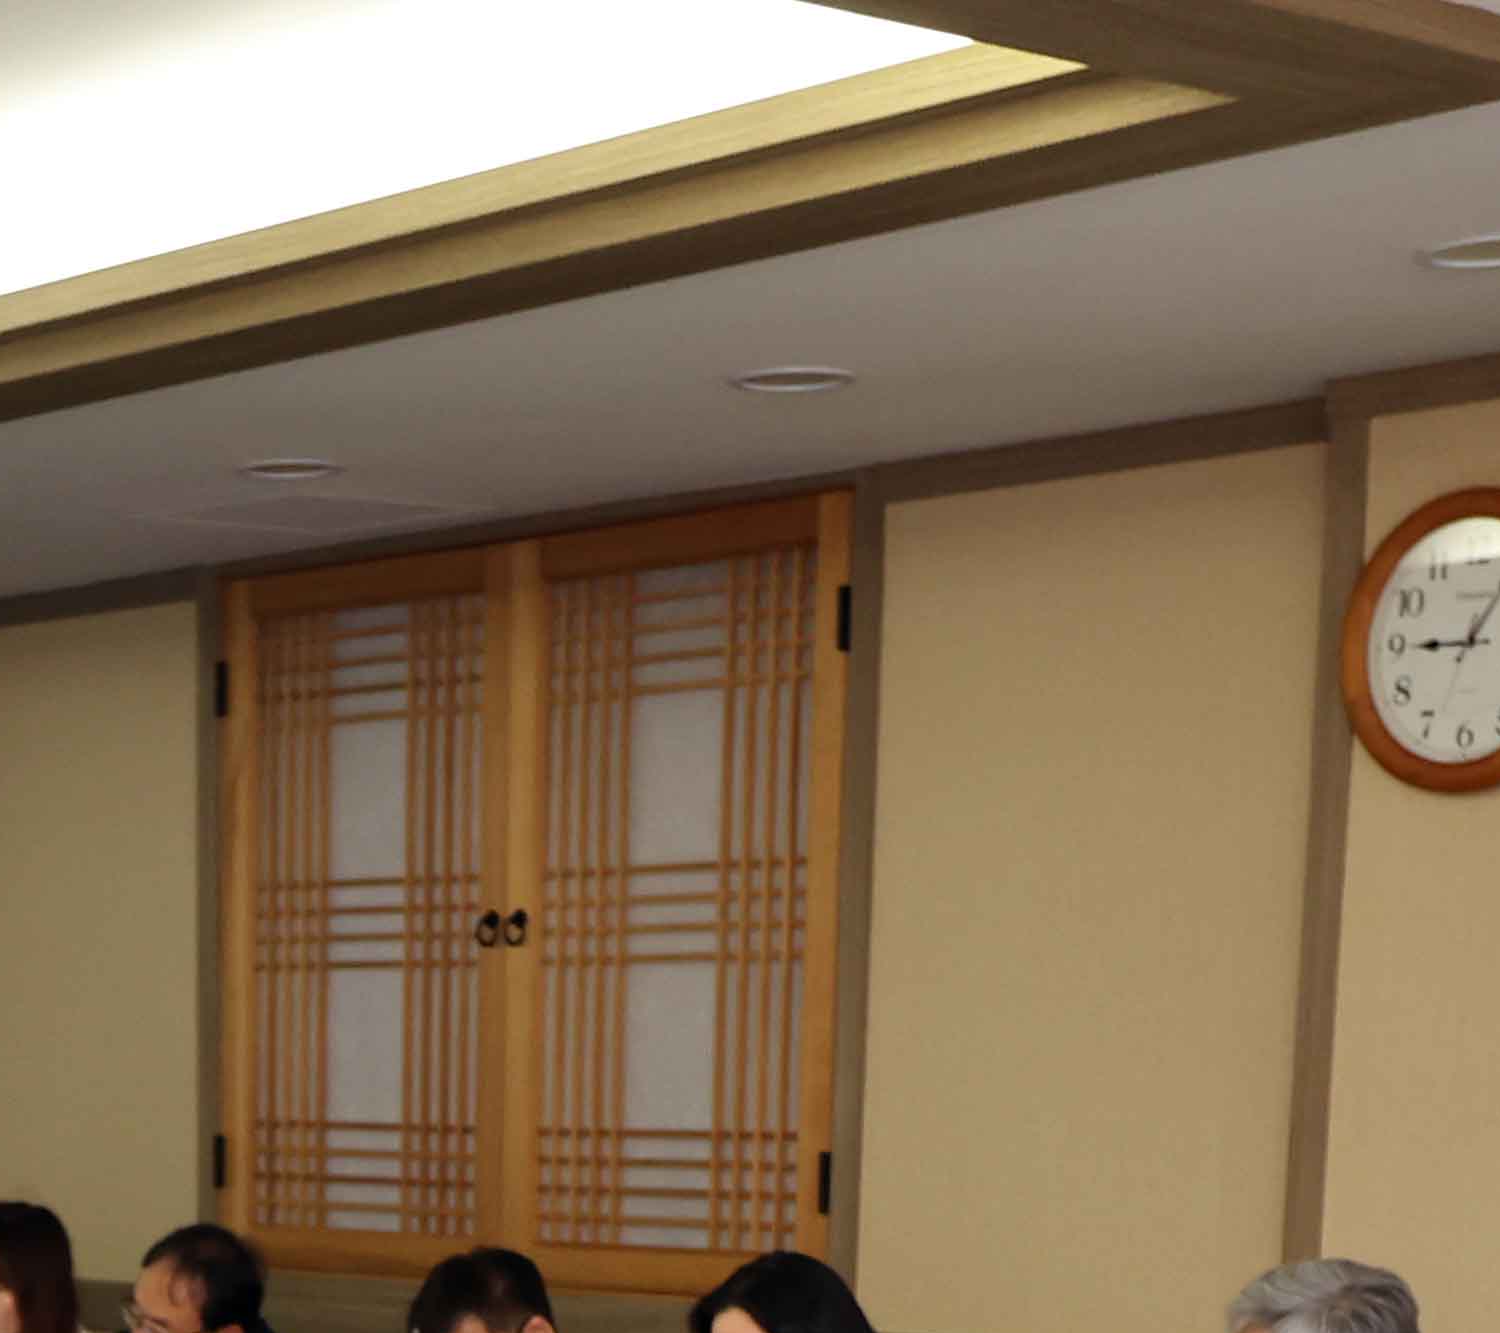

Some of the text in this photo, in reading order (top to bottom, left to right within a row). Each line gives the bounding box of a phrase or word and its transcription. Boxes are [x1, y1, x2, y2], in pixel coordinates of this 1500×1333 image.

[1398, 587, 1425, 618] 10
[1387, 633, 1406, 660] 9
[1393, 677, 1412, 706] 8
[1456, 721, 1475, 748] 6
